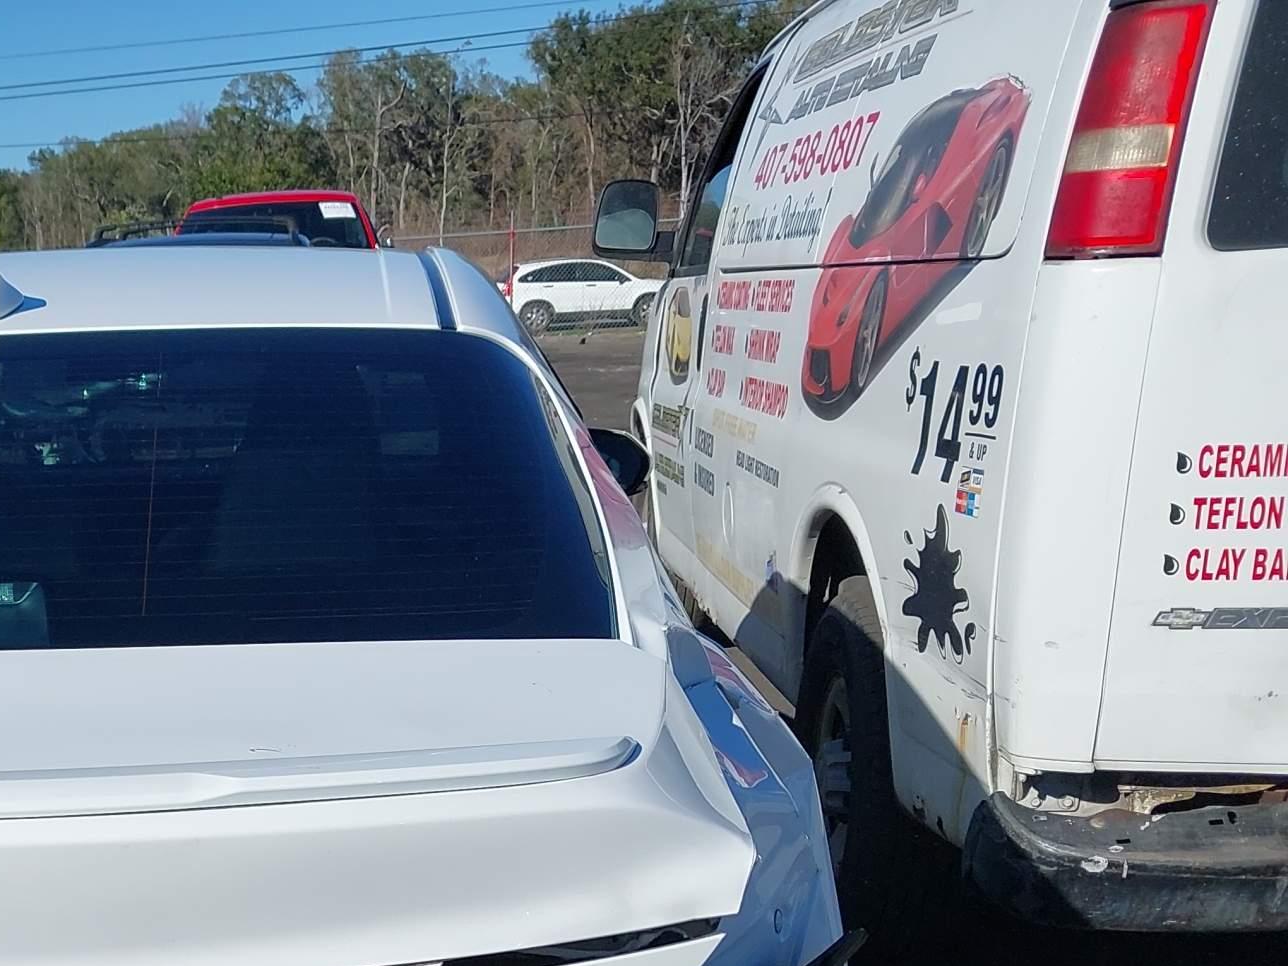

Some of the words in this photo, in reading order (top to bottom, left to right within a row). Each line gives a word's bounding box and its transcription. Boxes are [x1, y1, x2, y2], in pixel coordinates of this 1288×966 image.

[754, 111, 881, 191] 407-598-0807
[765, 202, 778, 241] in
[976, 444, 988, 461] UP
[1193, 496, 1285, 530] TEFLON
[1185, 548, 1247, 581] CLAY
[1252, 548, 1288, 581] BA
